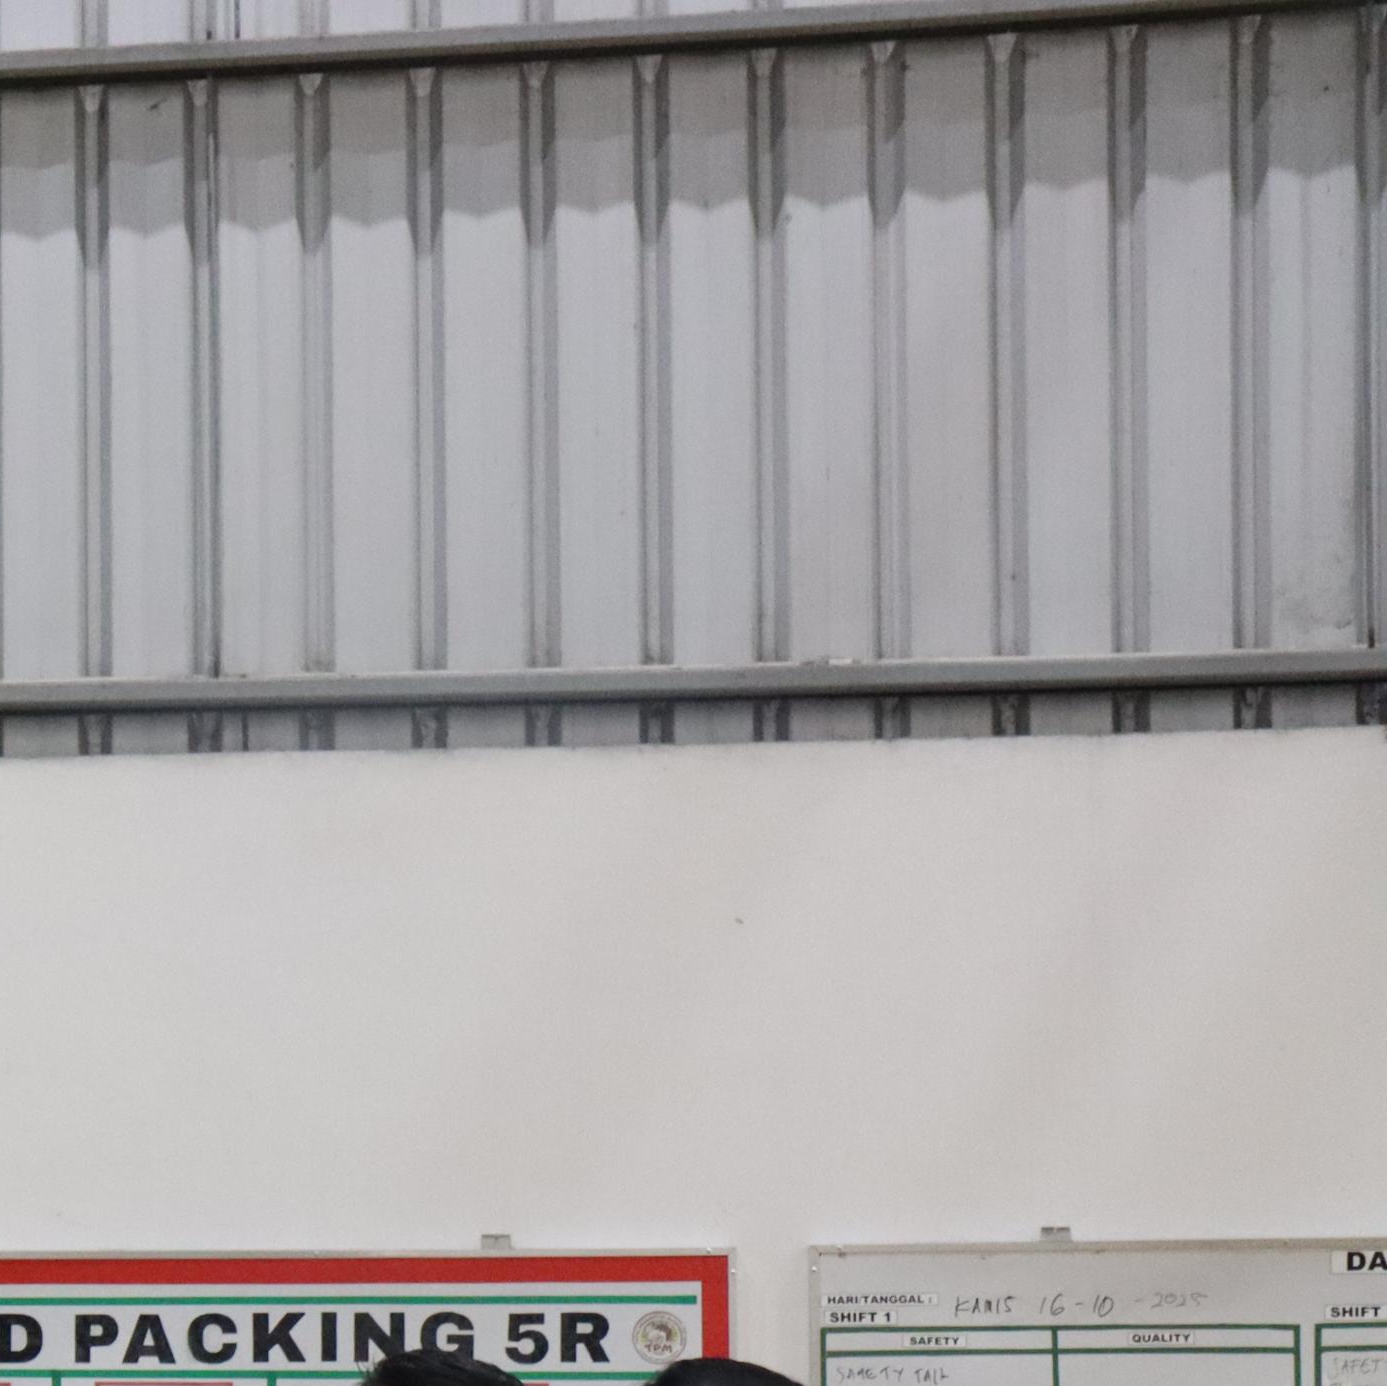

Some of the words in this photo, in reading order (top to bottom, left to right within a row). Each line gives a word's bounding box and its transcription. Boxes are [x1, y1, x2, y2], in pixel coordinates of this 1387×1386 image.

[829, 1311, 878, 1323] SHIFT
[883, 1311, 892, 1323] 1
[1330, 1306, 1381, 1318] SHIFT
[73, 1311, 476, 1364] PACKING
[505, 1311, 611, 1363] 5R
[909, 1336, 959, 1346] SAFETY
[1131, 1333, 1191, 1343] QUALITY
